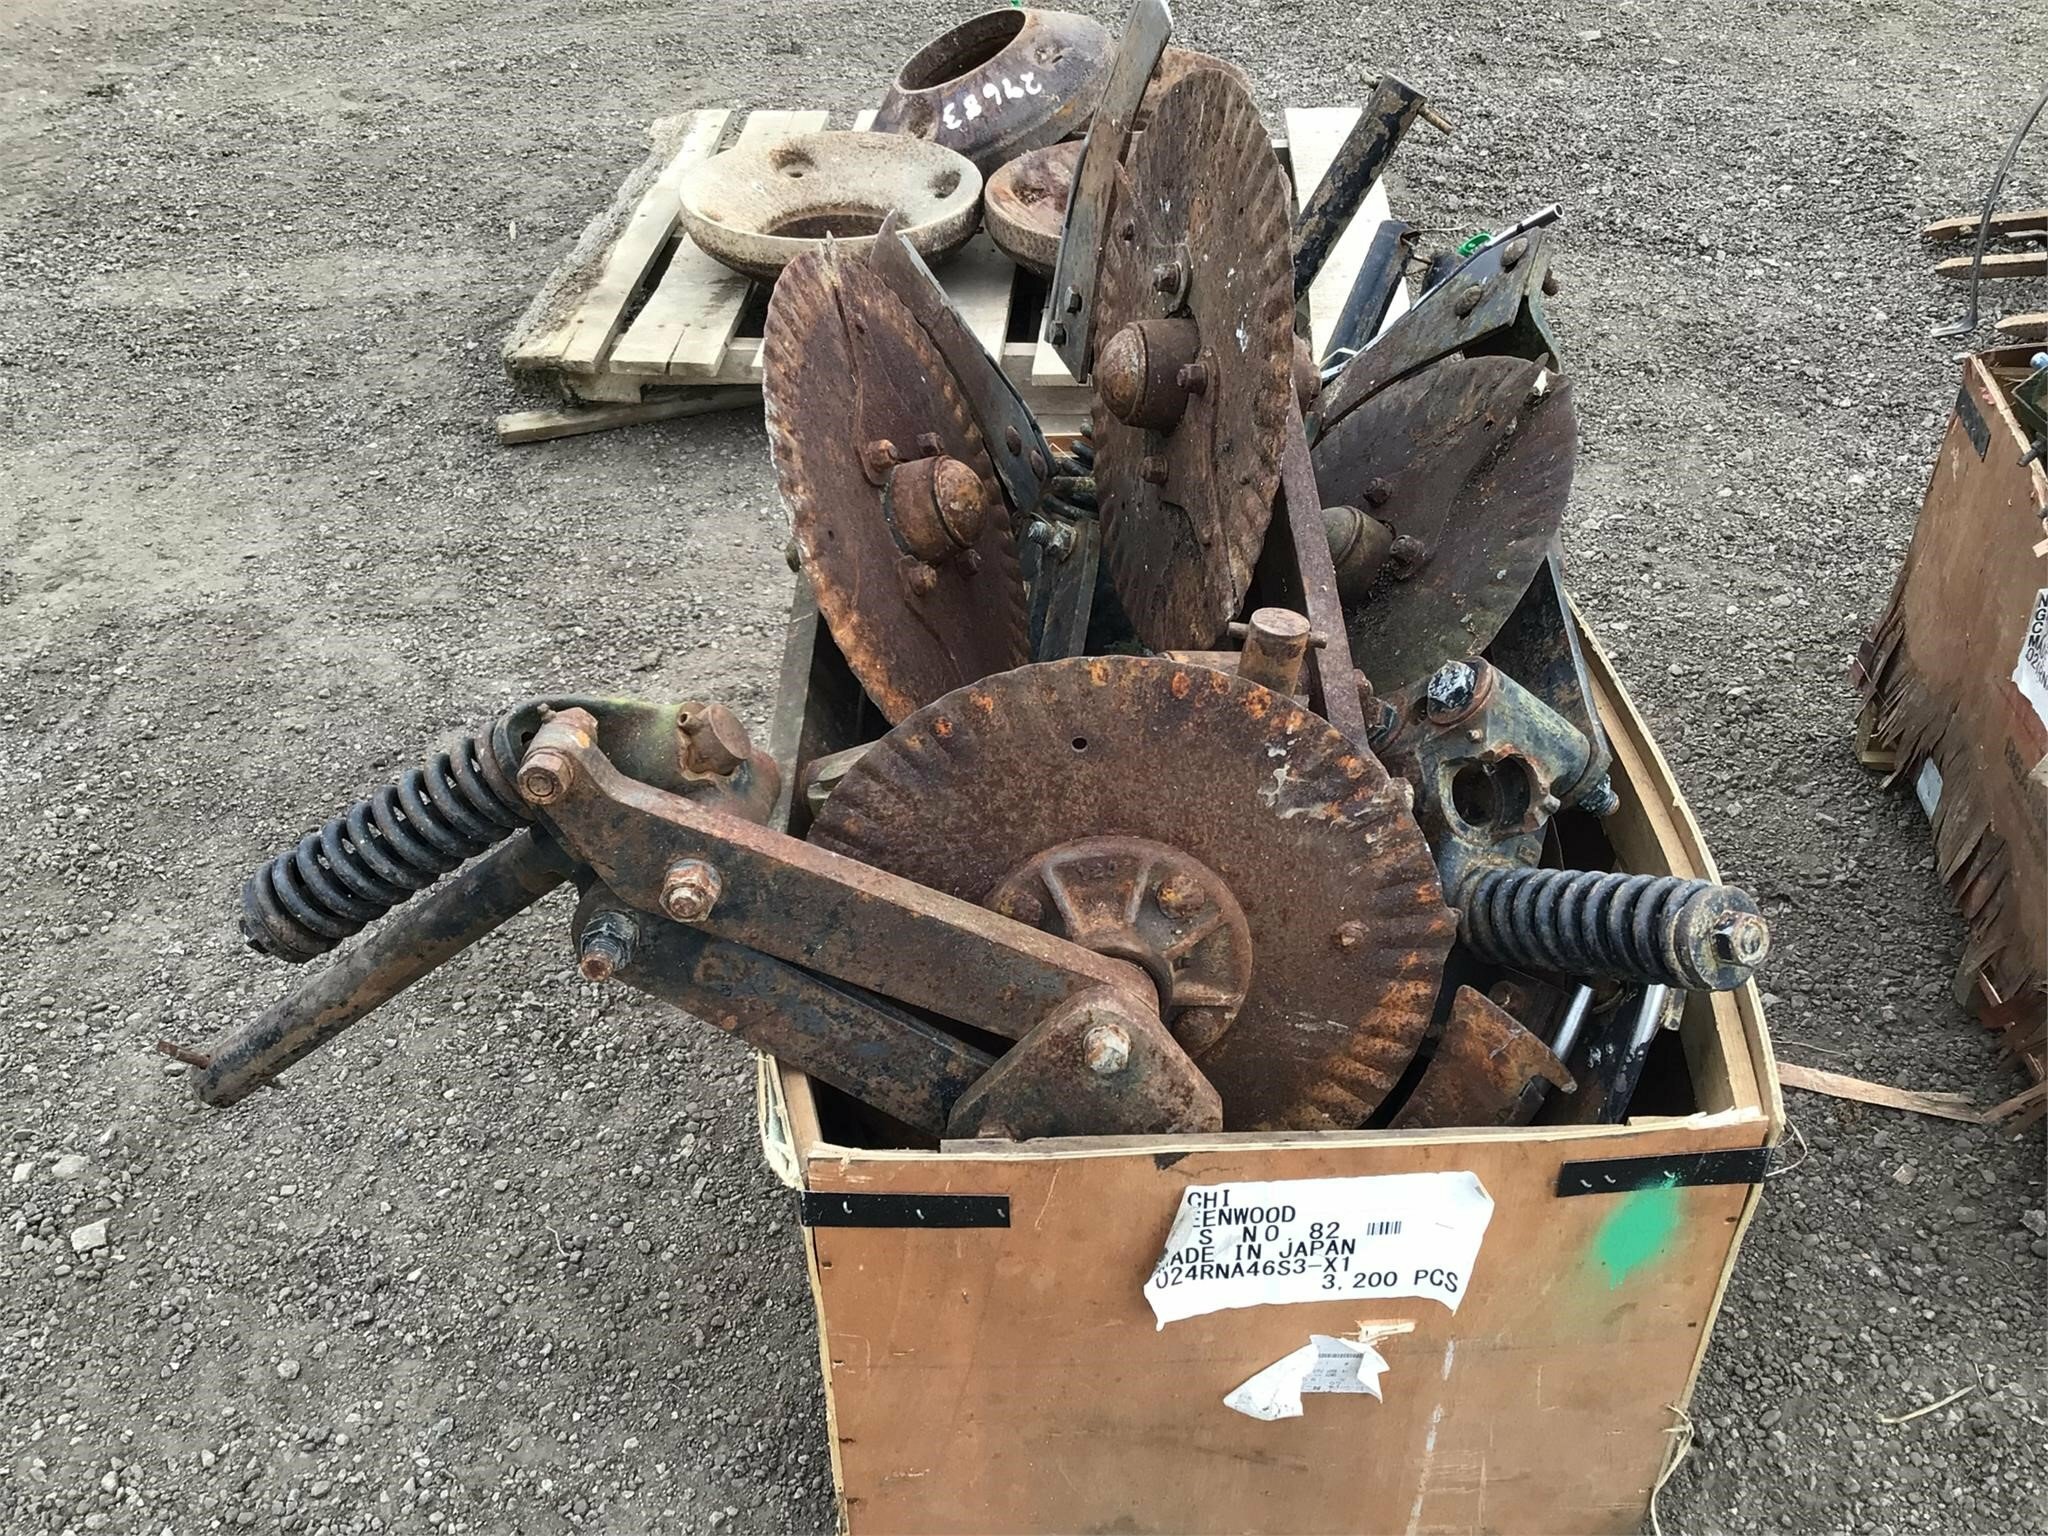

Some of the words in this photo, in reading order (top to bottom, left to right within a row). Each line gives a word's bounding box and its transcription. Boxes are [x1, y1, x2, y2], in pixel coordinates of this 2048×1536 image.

[1309, 1222, 1341, 1240] 82
[1159, 1246, 1215, 1272] ADE
[1235, 1243, 1262, 1261] IN
[1278, 1237, 1356, 1260] JAPAN
[1413, 1268, 1459, 1293] PCS
